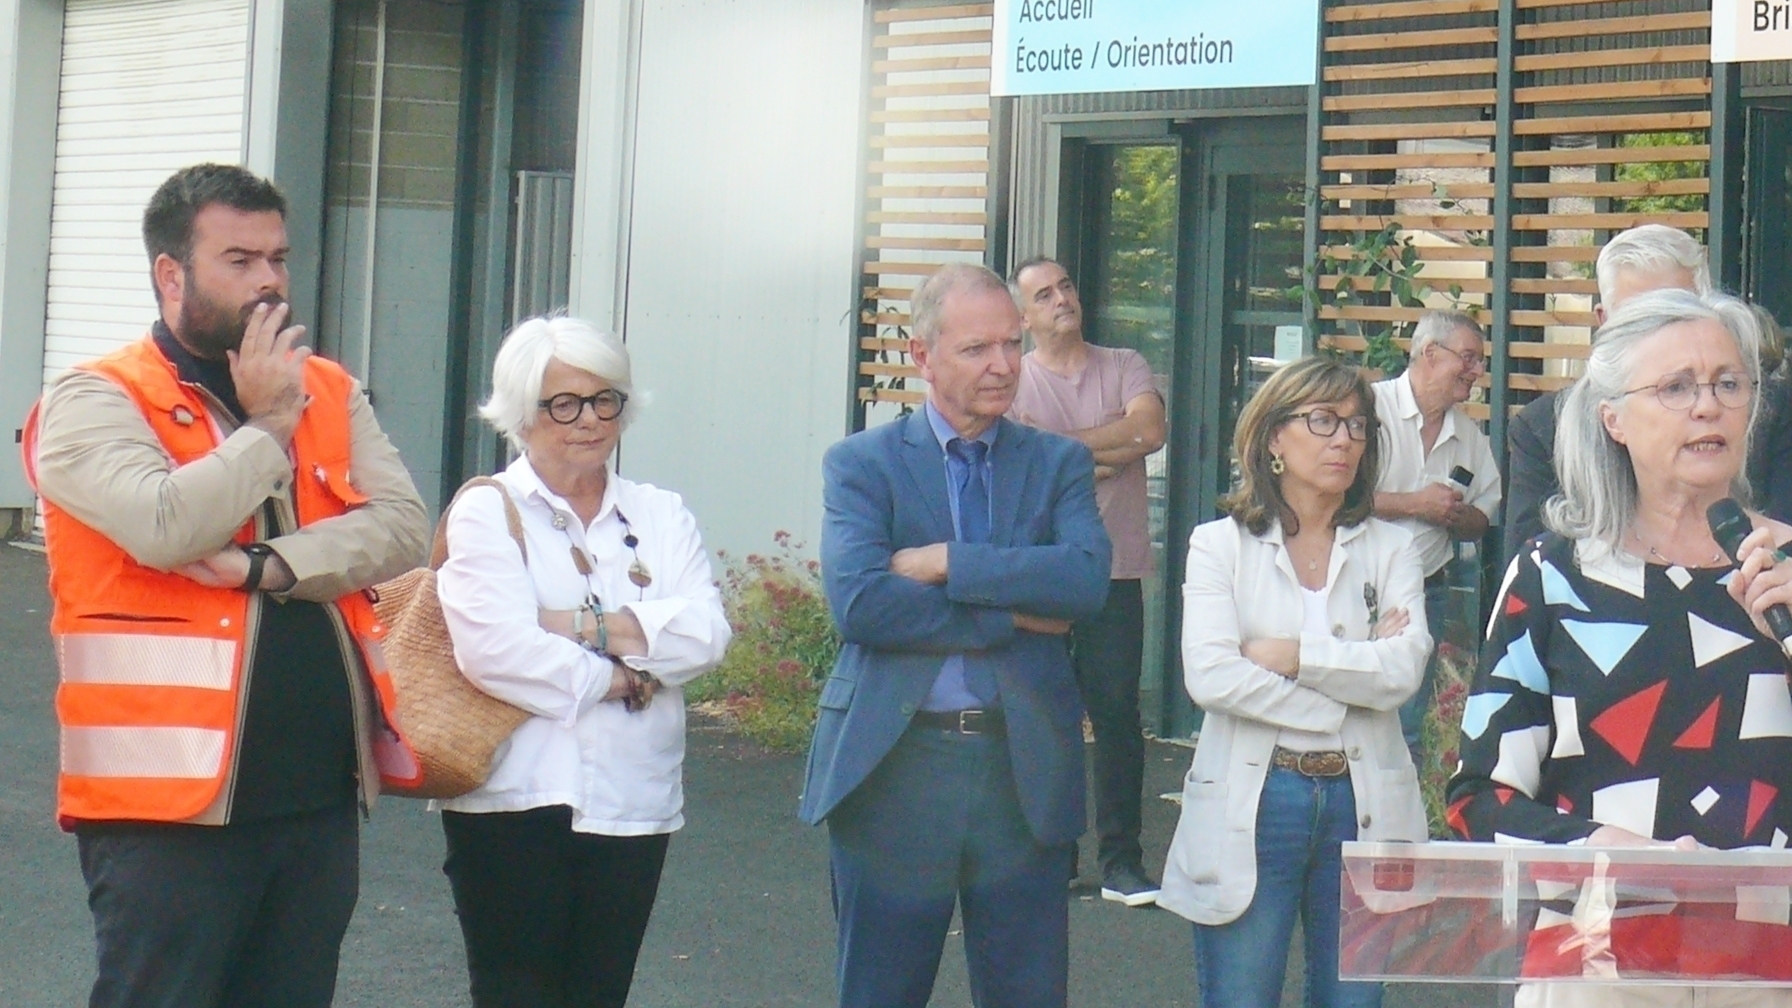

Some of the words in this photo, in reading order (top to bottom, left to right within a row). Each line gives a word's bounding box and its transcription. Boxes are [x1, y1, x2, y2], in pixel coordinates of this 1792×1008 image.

[1016, 37, 1083, 73] Écoute
[1091, 41, 1100, 69] /
[1107, 32, 1233, 69] Orientation
